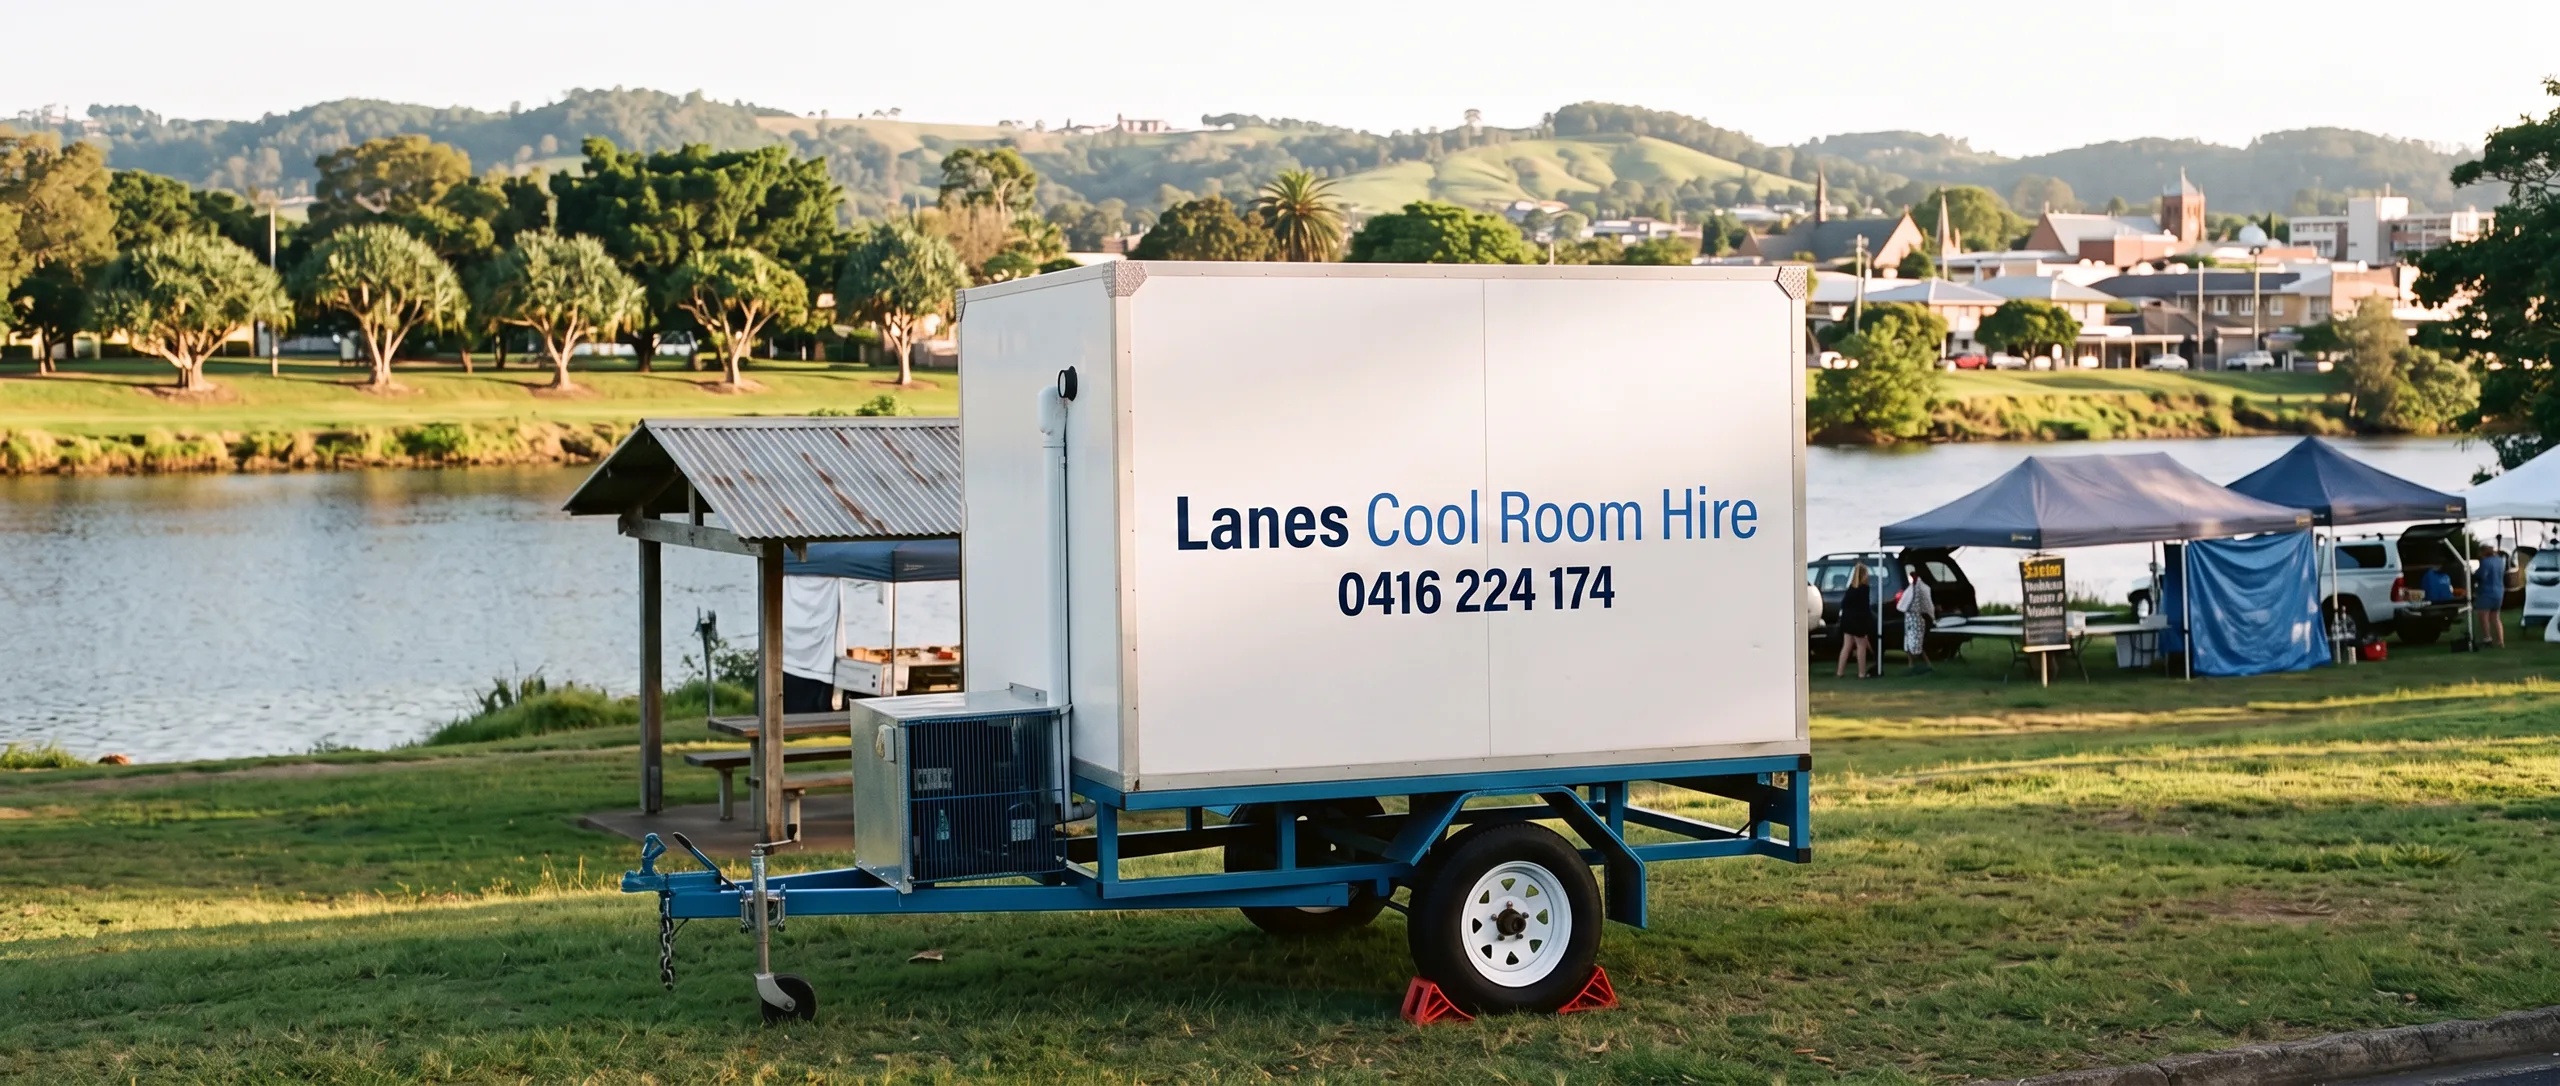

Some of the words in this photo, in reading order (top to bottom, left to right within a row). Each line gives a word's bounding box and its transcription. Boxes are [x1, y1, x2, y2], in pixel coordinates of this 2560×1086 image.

[1177, 496, 1349, 551] Lanes
[1367, 489, 1479, 547] Cool
[1501, 491, 1642, 544] Room
[1663, 486, 1758, 540] Hire
[1338, 569, 1442, 617] 0416
[1455, 567, 1537, 613] 224
[1549, 565, 1616, 610] 174
